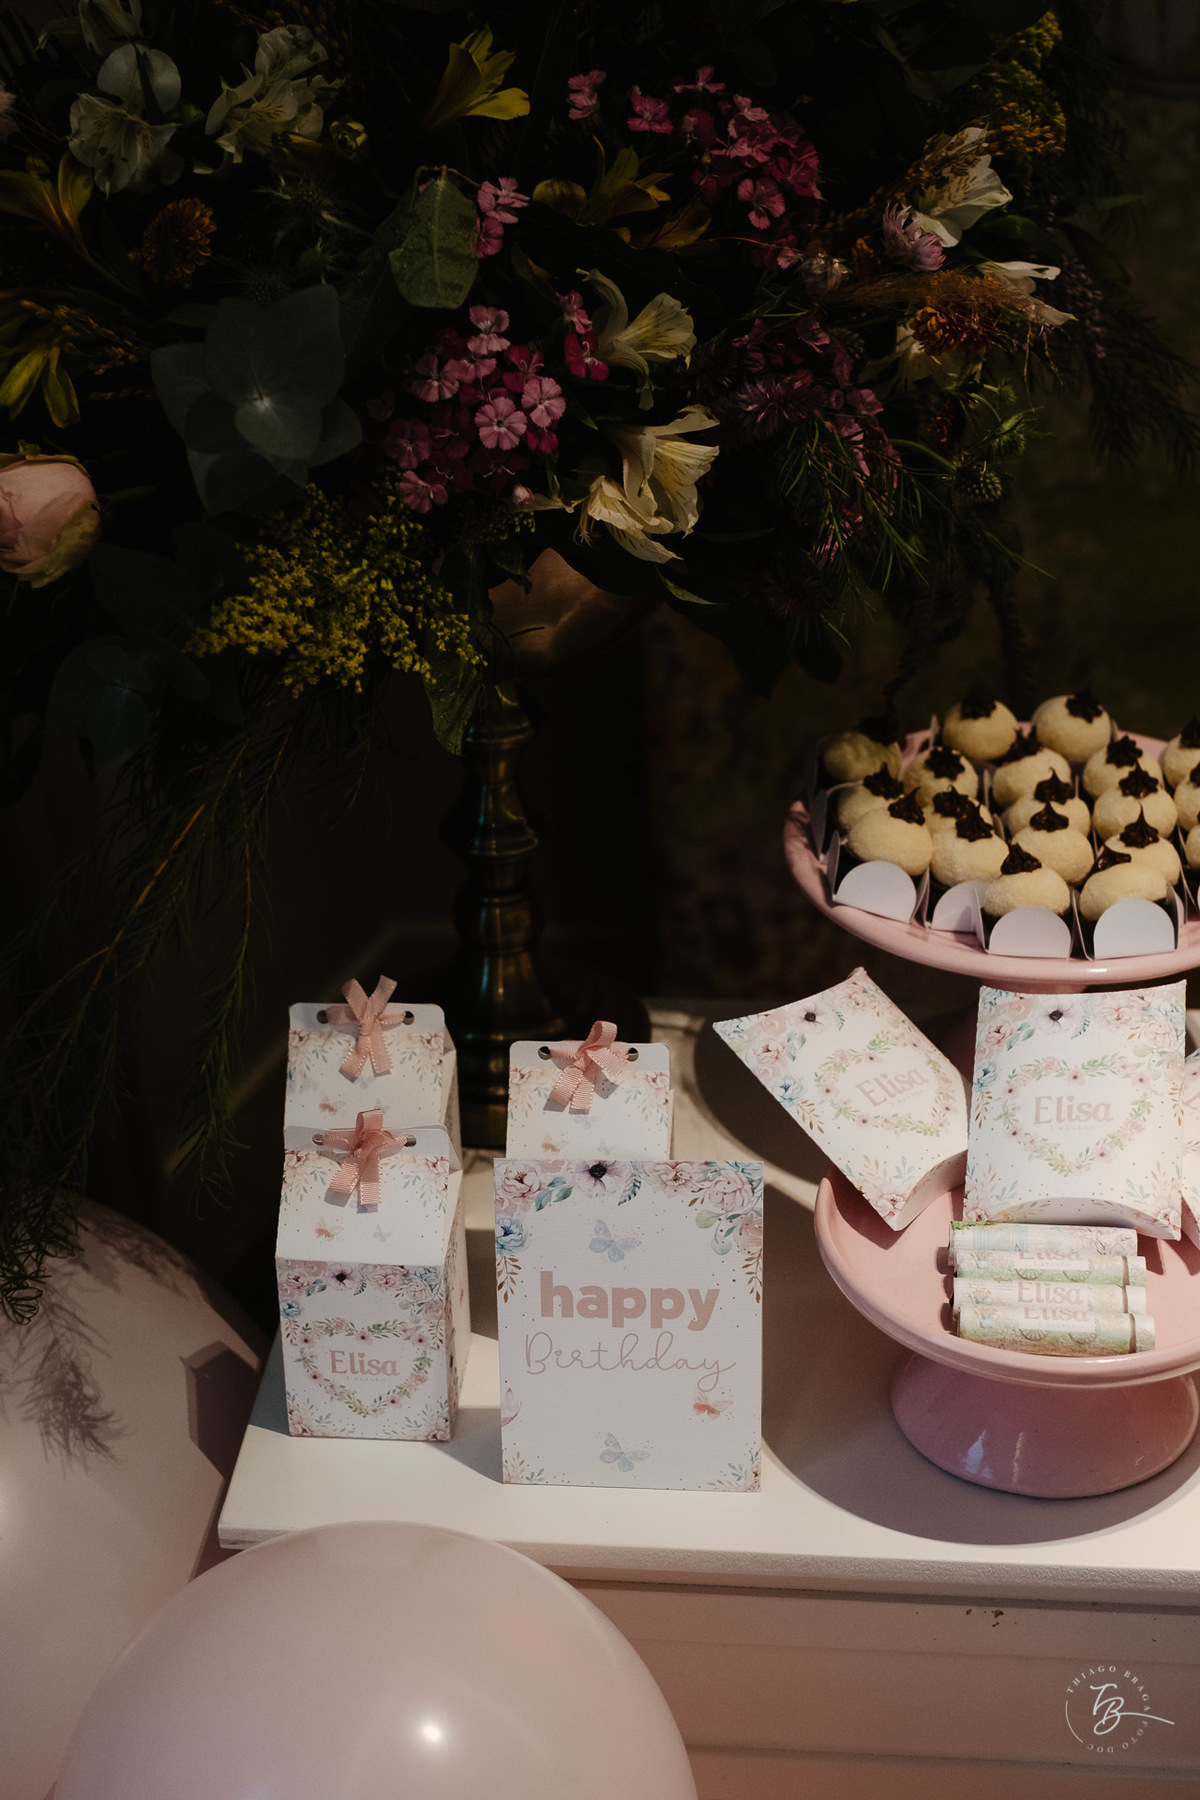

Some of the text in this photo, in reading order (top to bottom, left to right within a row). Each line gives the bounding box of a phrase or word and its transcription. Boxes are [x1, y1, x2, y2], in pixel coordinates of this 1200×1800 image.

[855, 1069, 930, 1107] Elisa
[1033, 1094, 1115, 1125] Elisa
[540, 1271, 720, 1331] happy
[1017, 1282, 1084, 1304] Elisa
[329, 1350, 401, 1377] Elisa
[525, 1331, 737, 1392] Birthday
